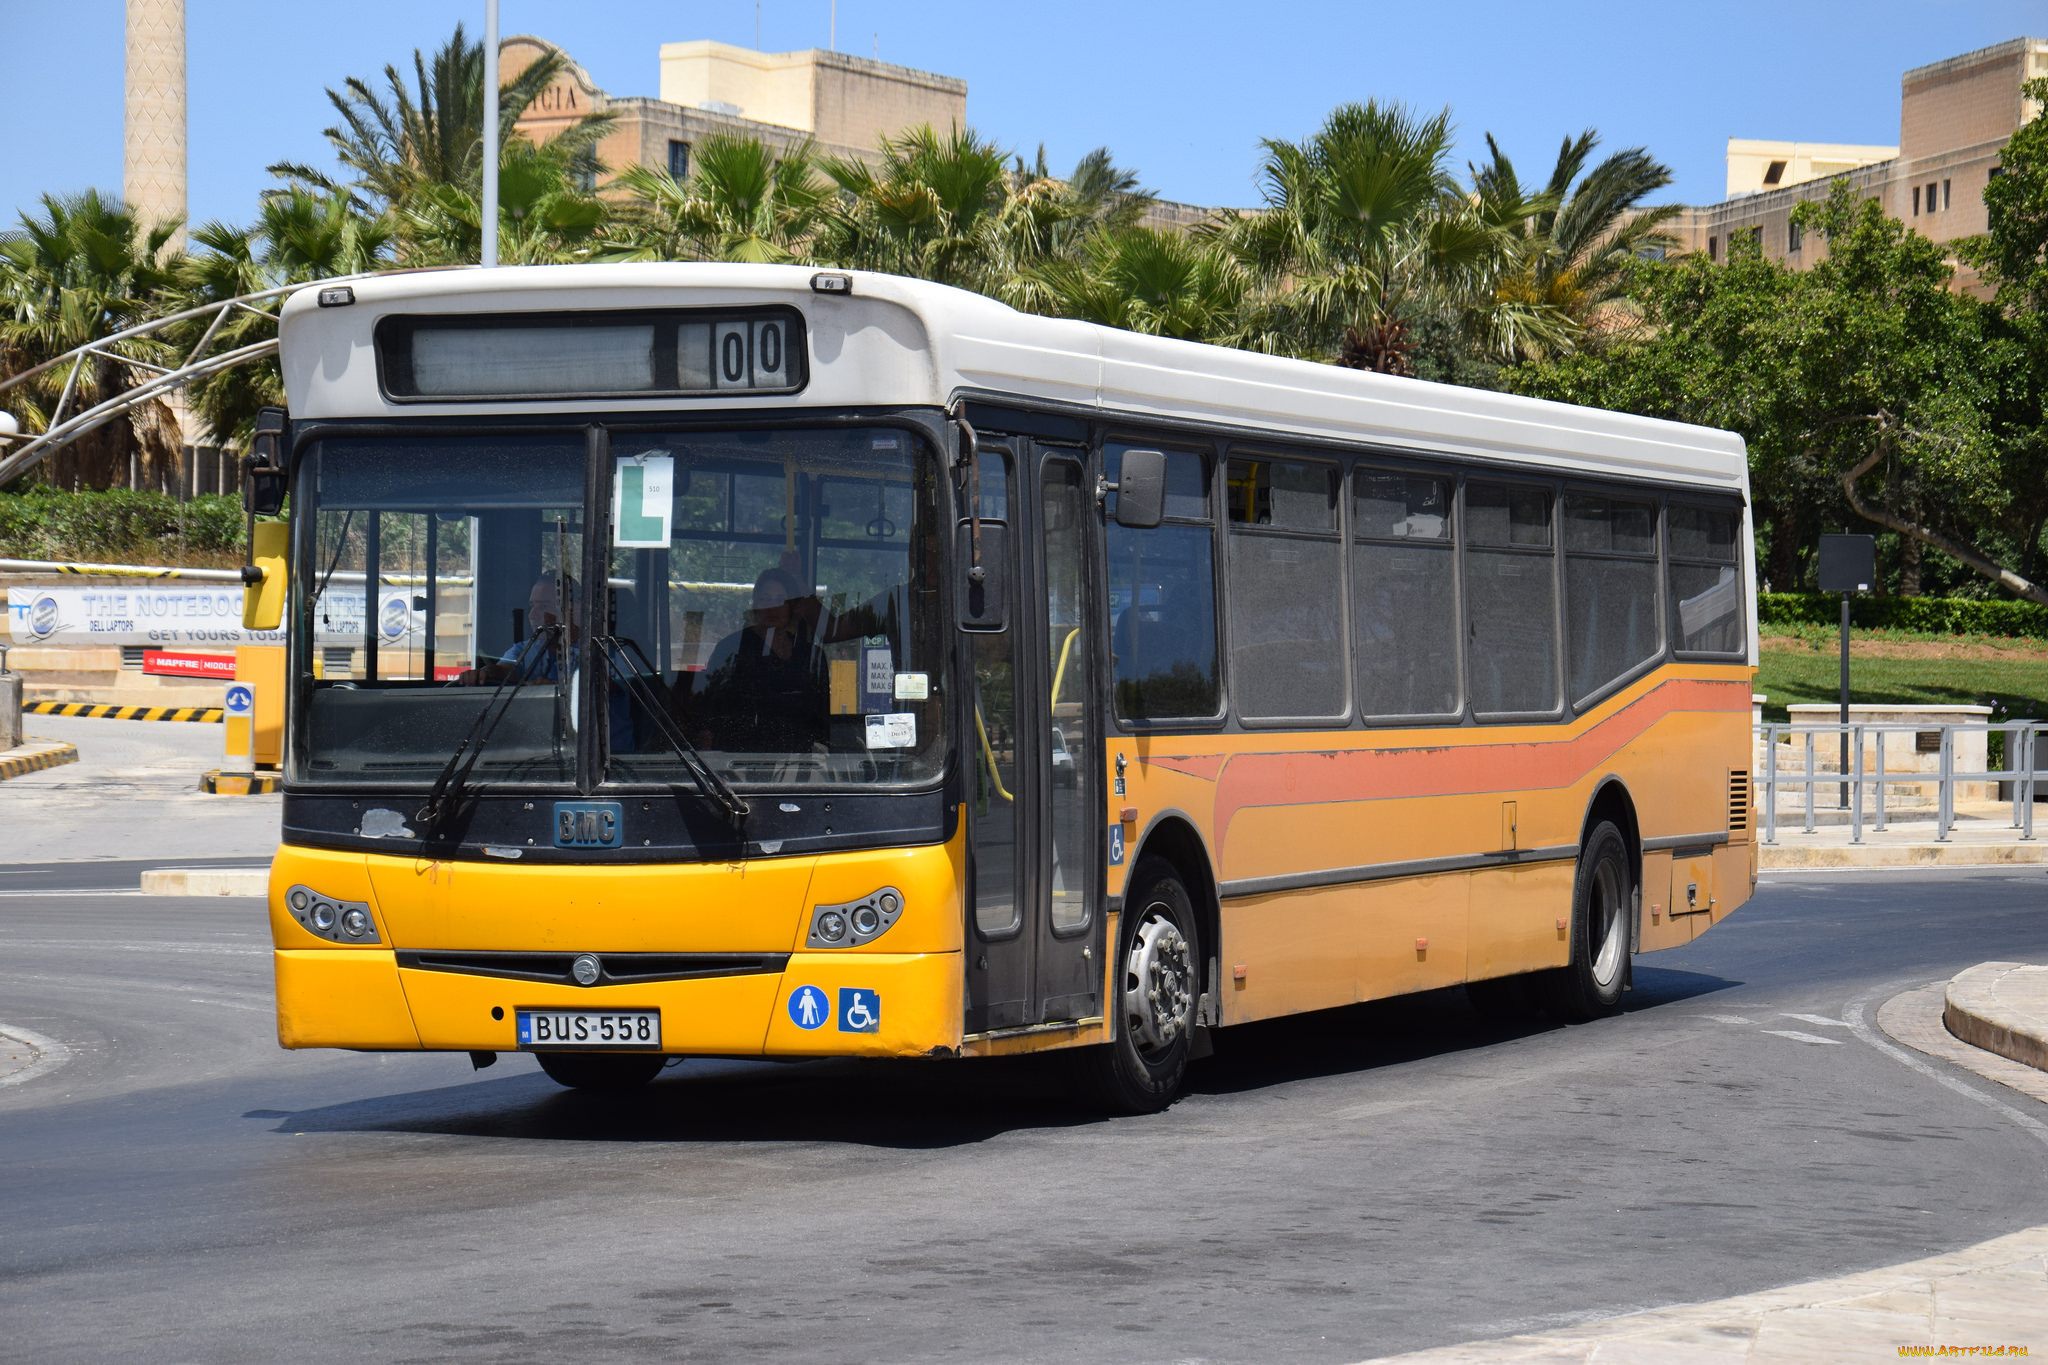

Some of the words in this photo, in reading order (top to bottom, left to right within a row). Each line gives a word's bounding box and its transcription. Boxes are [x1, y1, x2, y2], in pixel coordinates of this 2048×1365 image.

[81, 594, 127, 617] THE
[135, 594, 243, 617] NOTEBOO
[89, 620, 105, 632] DELL
[106, 620, 134, 632] LAPTOPS
[148, 630, 178, 641] GET
[185, 630, 240, 641] YOURS
[156, 657, 199, 669] MAPFRE
[204, 661, 236, 672] MIDDLES
[559, 809, 616, 842] BMC
[536, 1016, 588, 1041] BUS
[600, 1016, 650, 1041] 558
